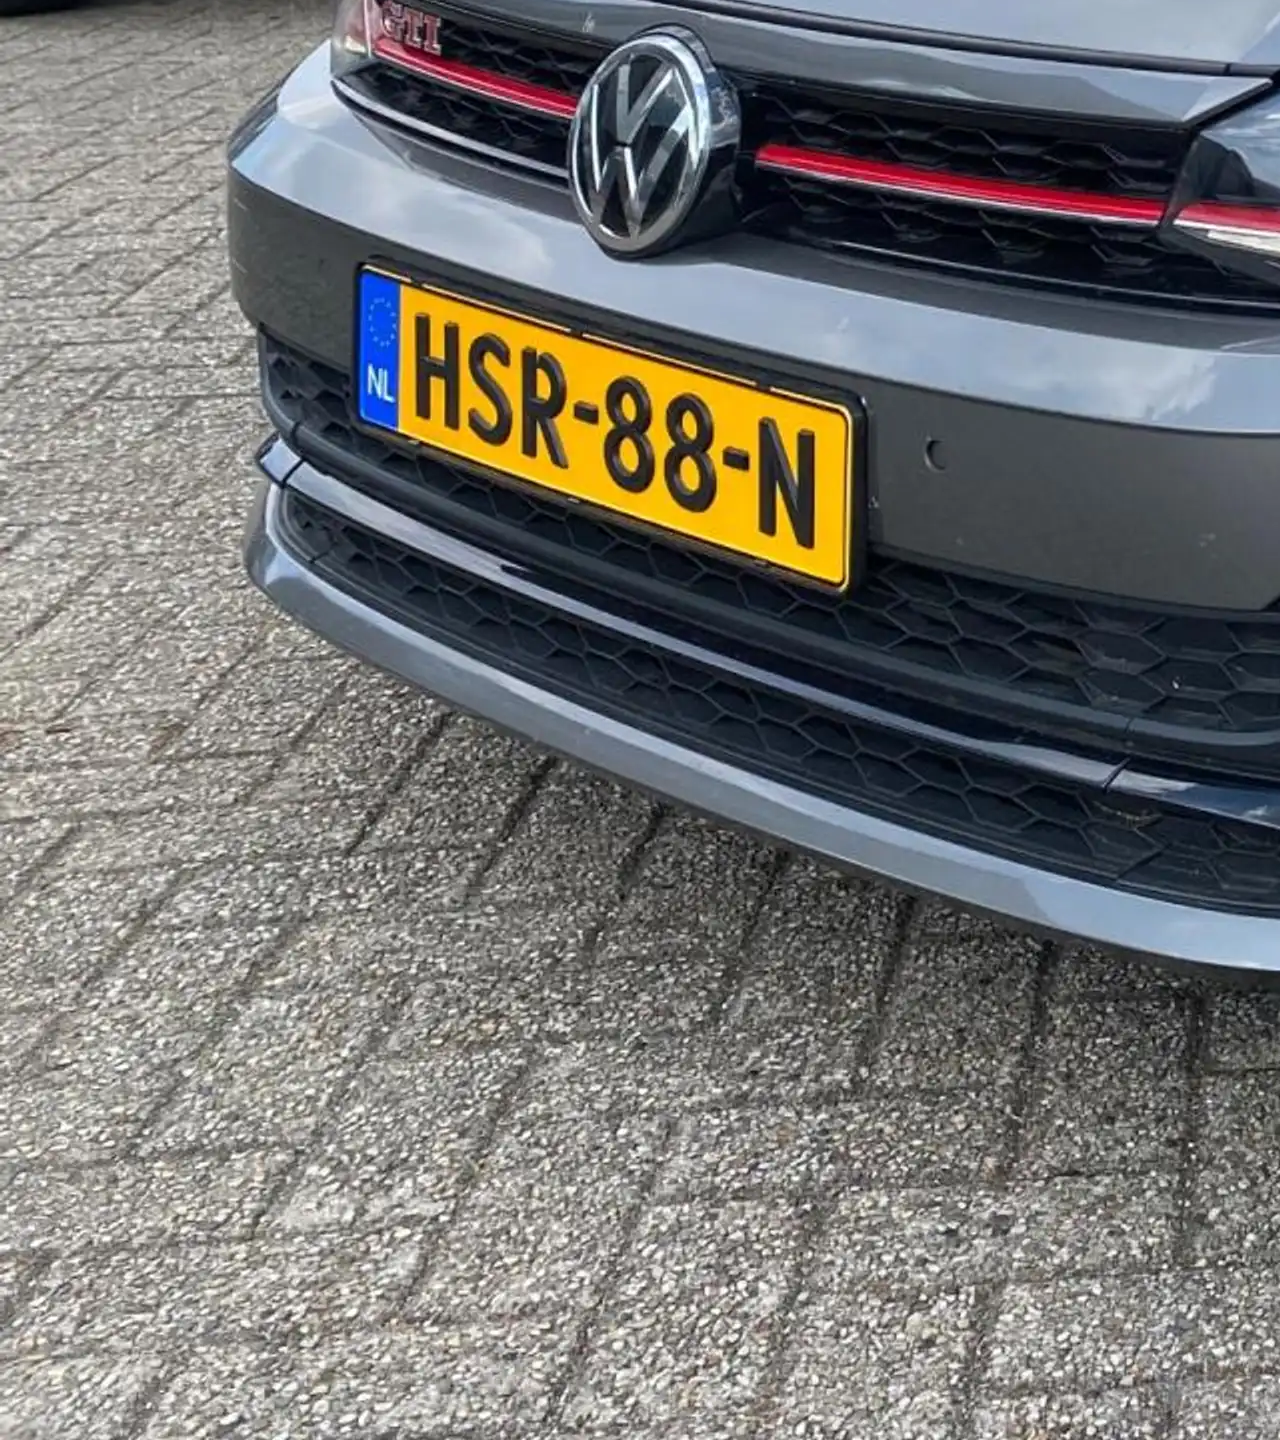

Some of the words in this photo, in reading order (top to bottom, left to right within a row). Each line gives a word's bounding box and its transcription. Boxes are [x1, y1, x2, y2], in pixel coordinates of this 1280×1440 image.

[382, 0, 442, 56] GTI
[367, 364, 395, 403] NL
[414, 312, 816, 550] HSR-88-N
